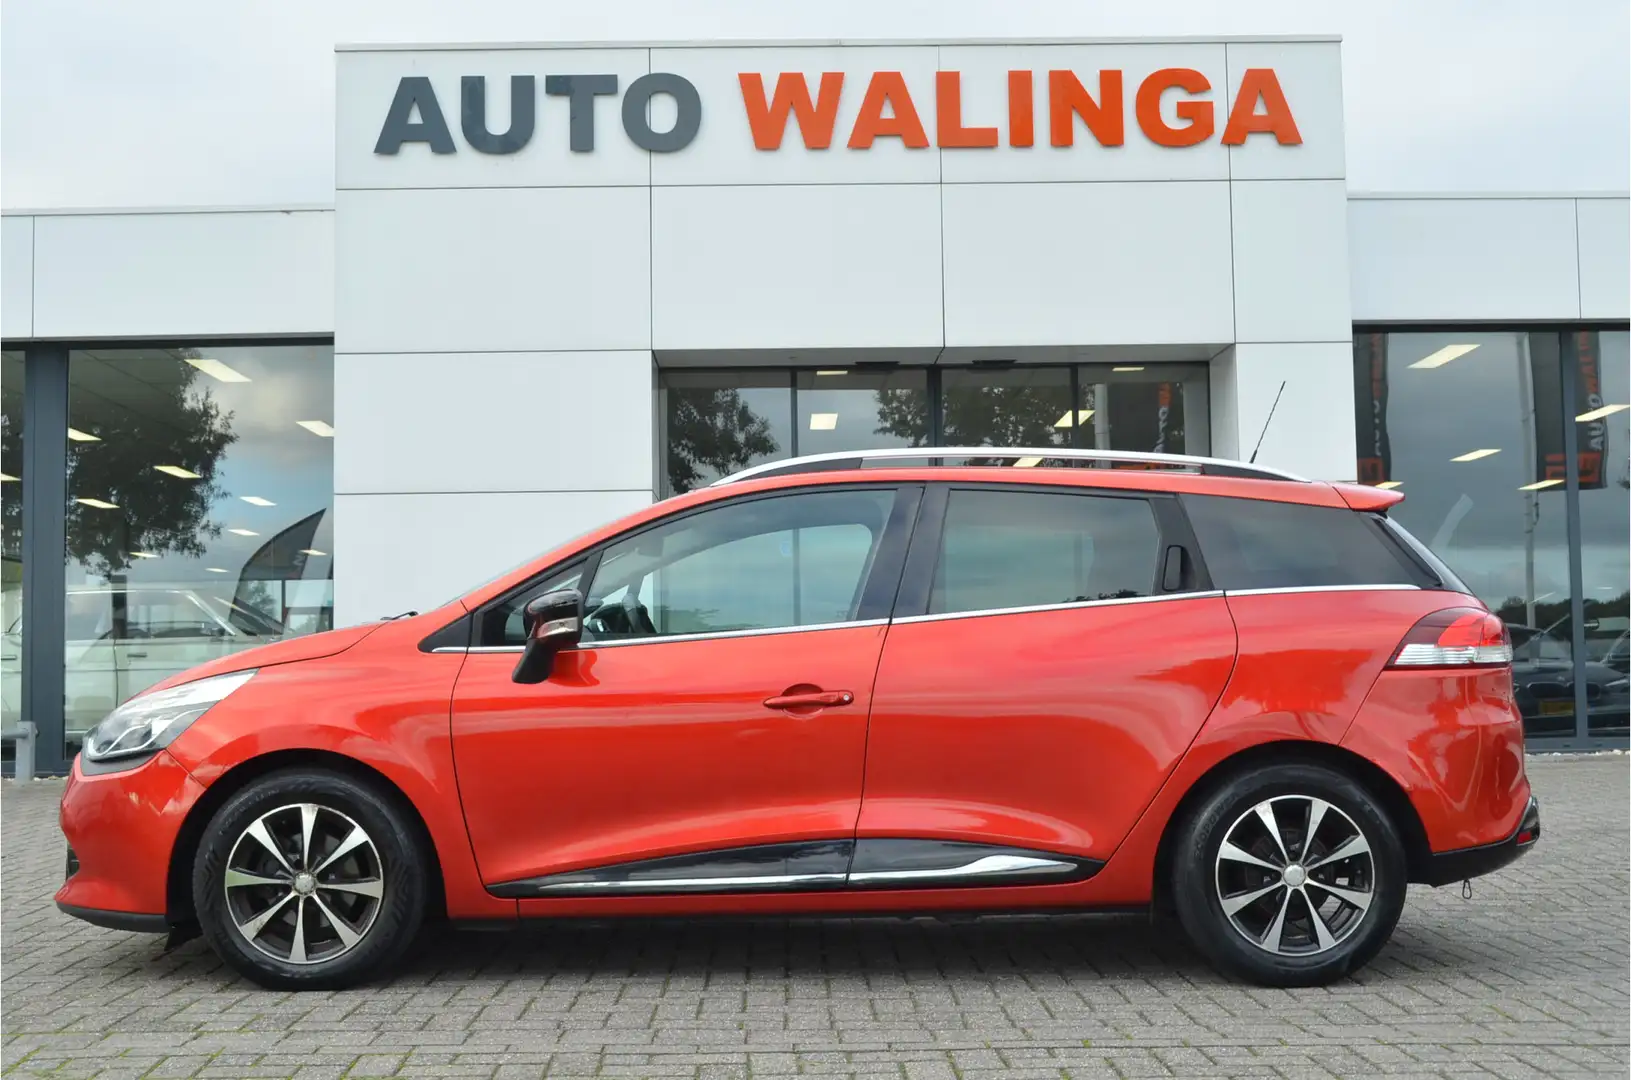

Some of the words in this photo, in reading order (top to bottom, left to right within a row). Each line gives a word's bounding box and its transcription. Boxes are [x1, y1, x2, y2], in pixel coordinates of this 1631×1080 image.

[374, 73, 701, 154] AUTO
[738, 68, 1303, 149] WALINGA
[1587, 393, 1605, 451] AUO
